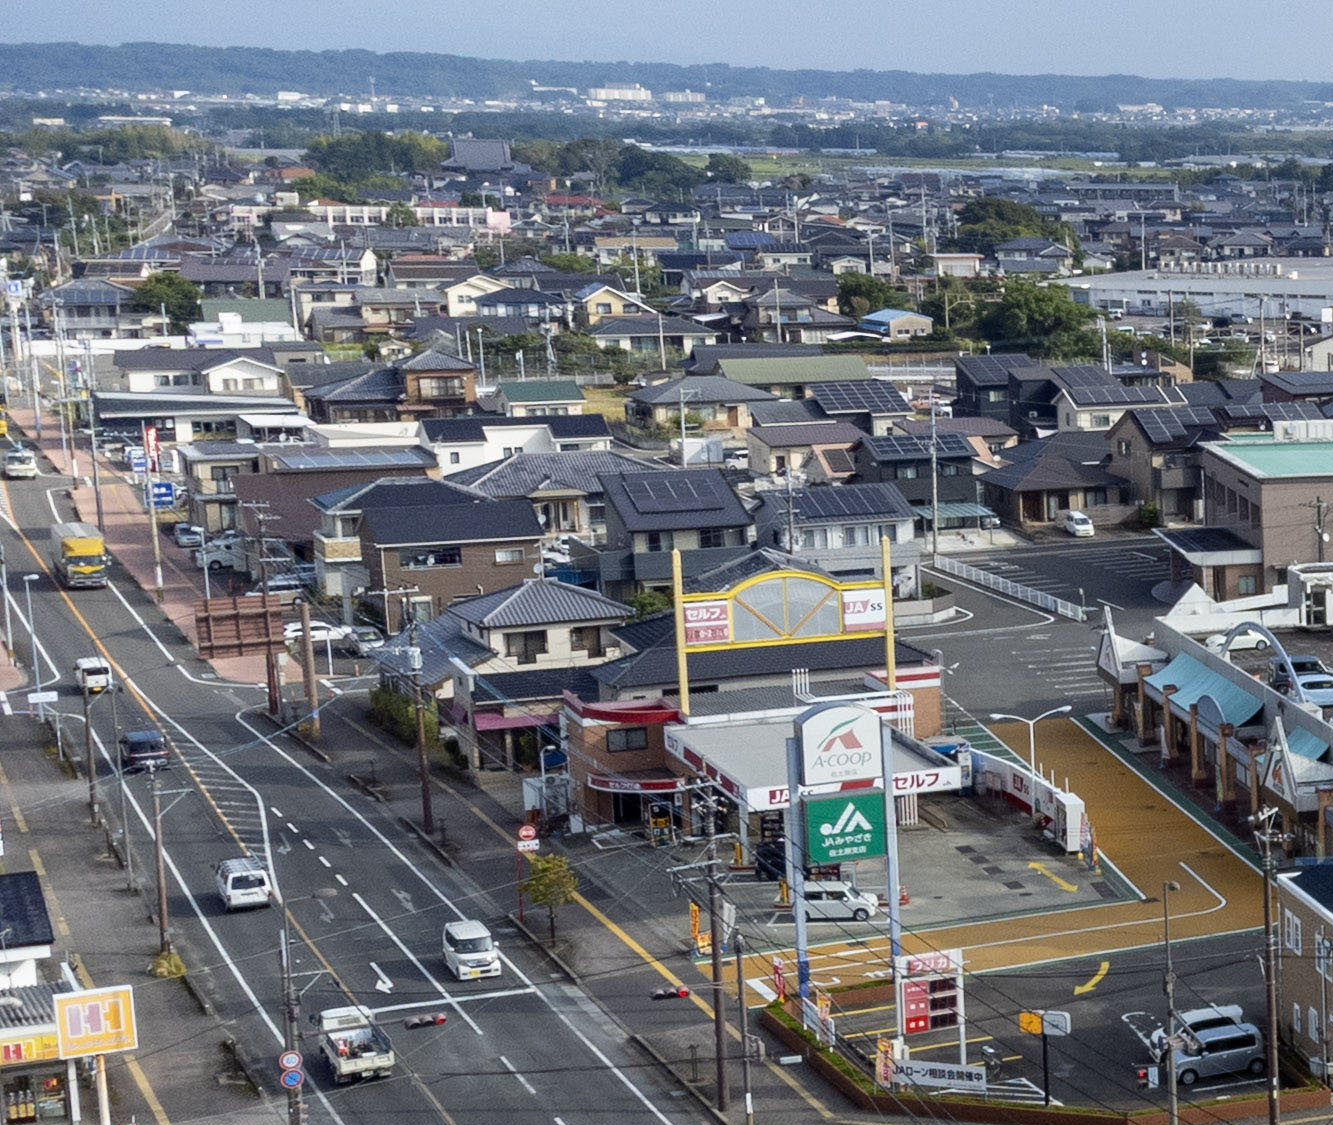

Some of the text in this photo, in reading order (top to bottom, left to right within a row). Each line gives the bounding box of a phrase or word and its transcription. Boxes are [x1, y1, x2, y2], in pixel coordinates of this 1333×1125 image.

[685, 607, 721, 621] セルフ
[845, 601, 883, 613] JA SS
[893, 772, 940, 790] セルフ
[893, 1065, 984, 1083] JAローン相談会開催中
